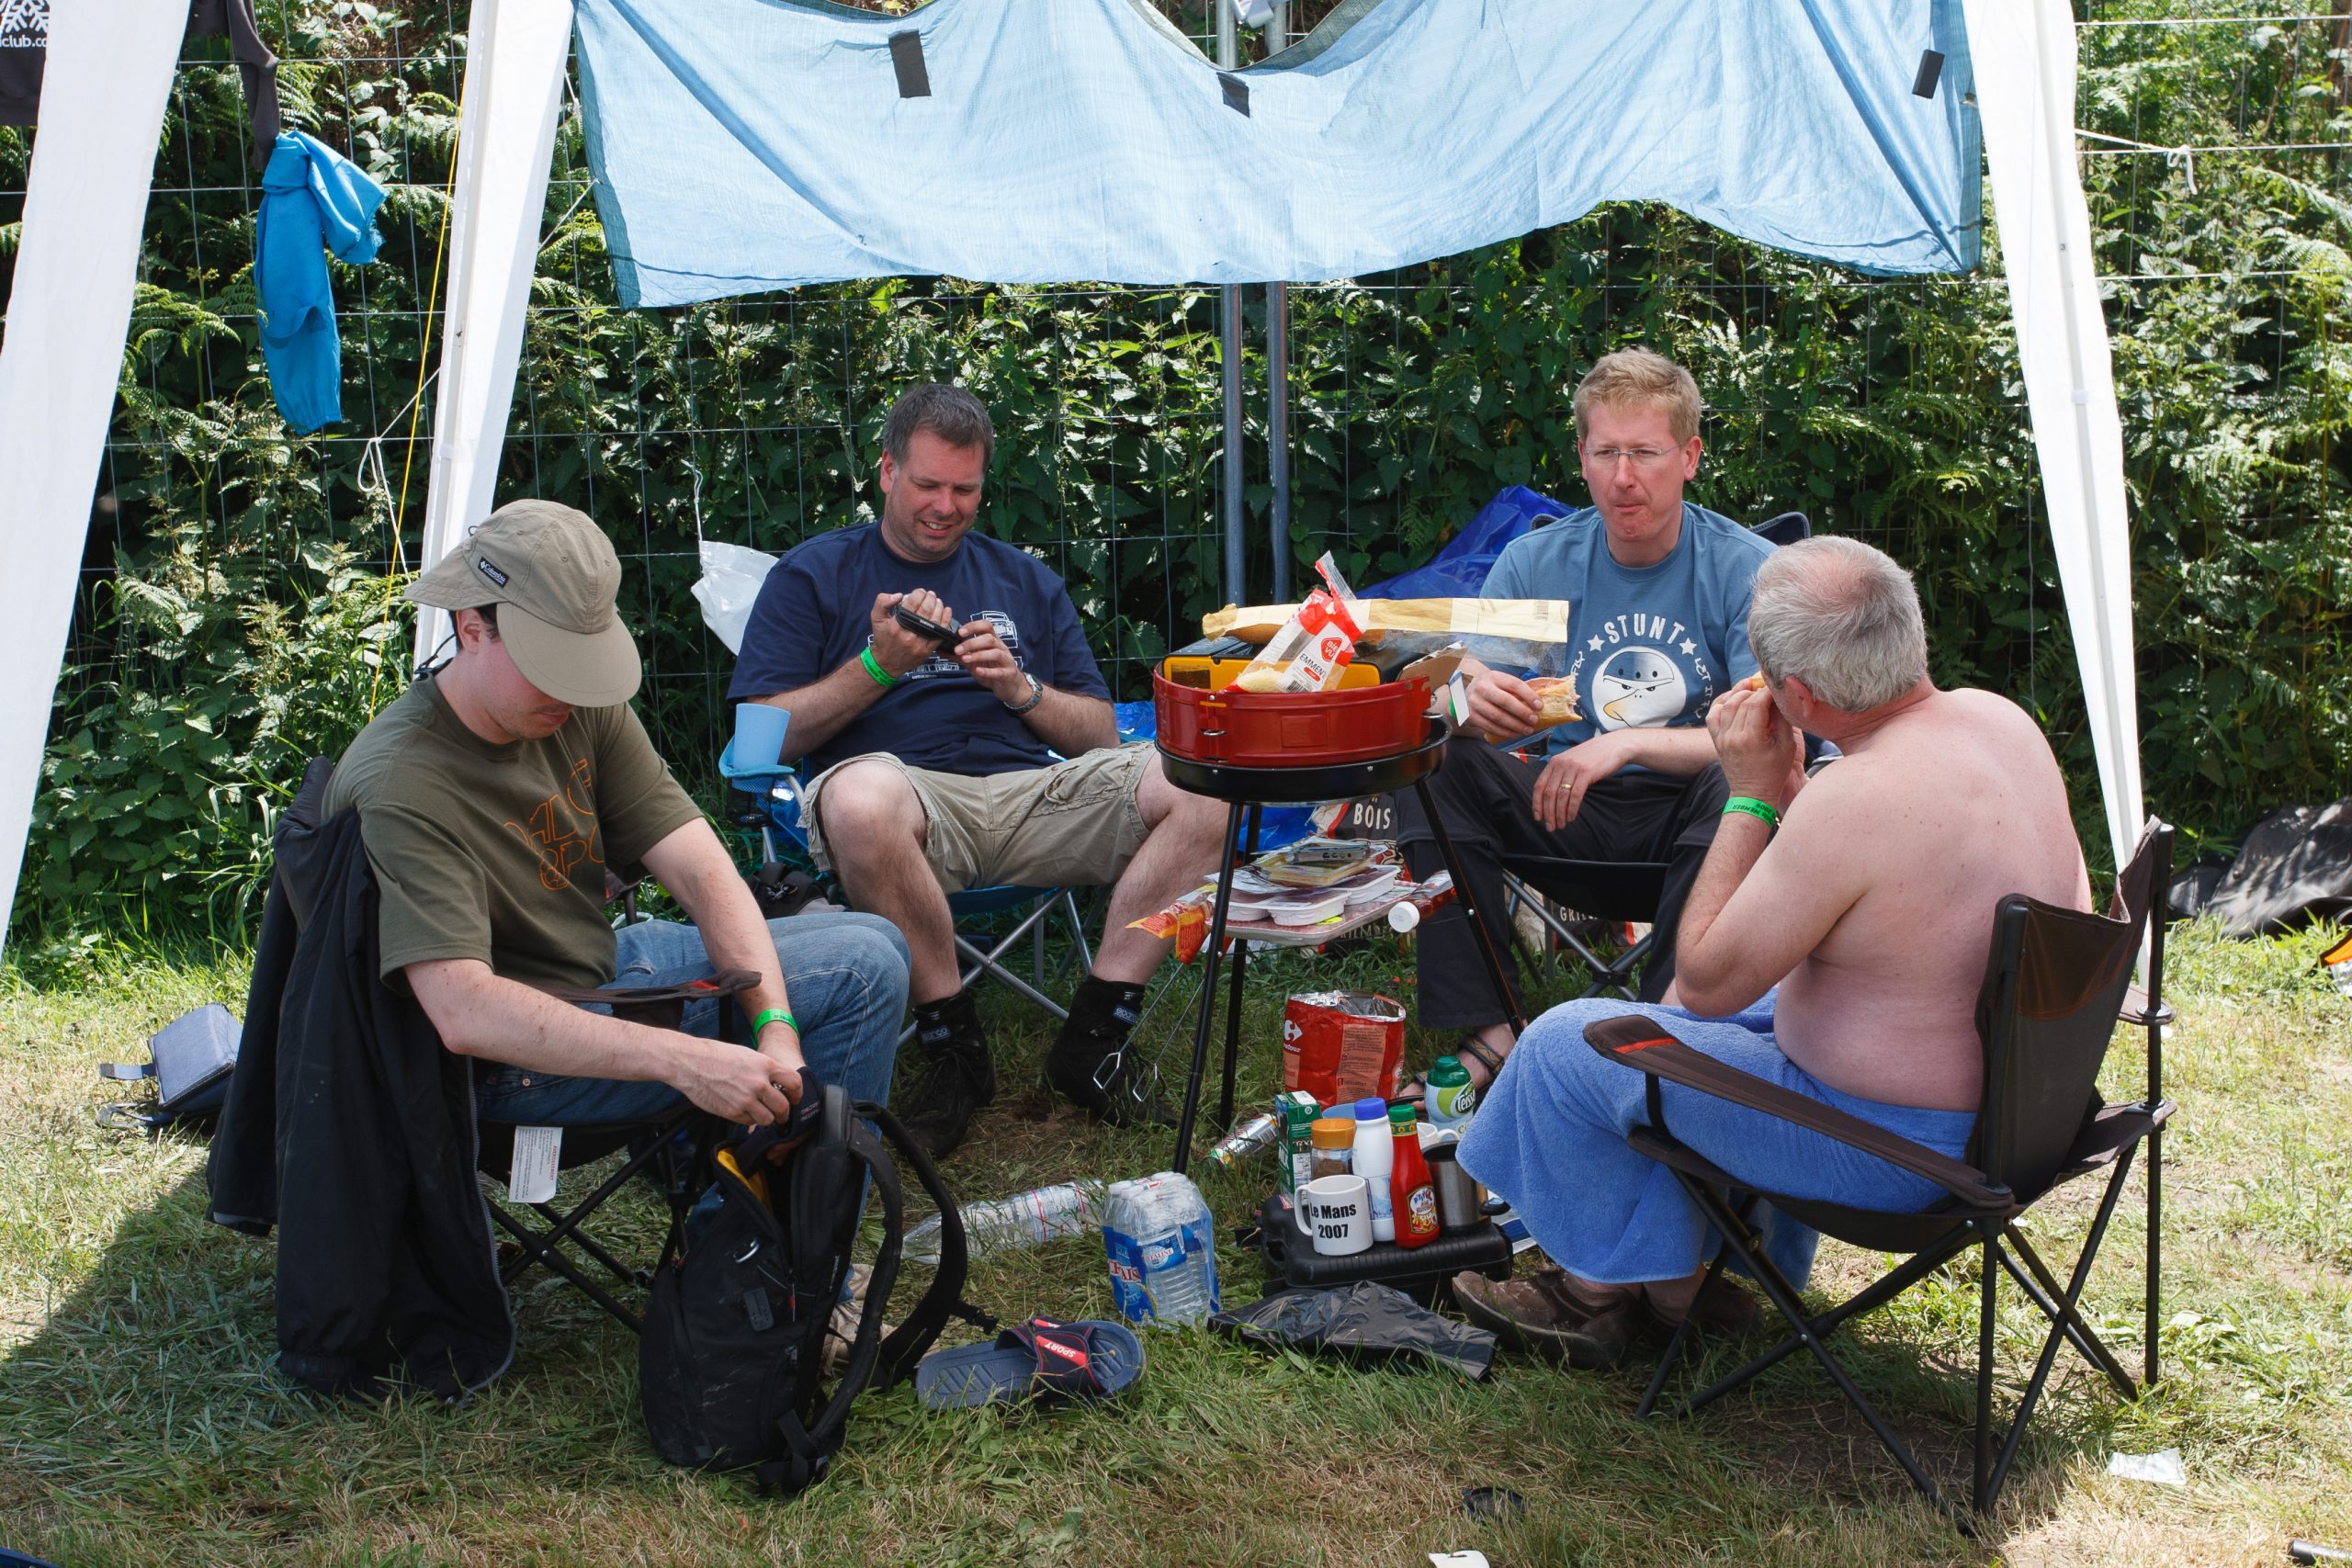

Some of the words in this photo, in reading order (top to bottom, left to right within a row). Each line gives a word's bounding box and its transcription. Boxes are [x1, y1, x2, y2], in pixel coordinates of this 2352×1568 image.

[1604, 614, 1685, 644] STUNT
[1694, 657, 1711, 681] LET
[1353, 803, 1391, 829] BOIS
[1310, 1201, 1319, 1218] Le
[1320, 1204, 1357, 1219] Mans
[1318, 1224, 1349, 1239] 2007
[1045, 1342, 1076, 1358] SPORT
